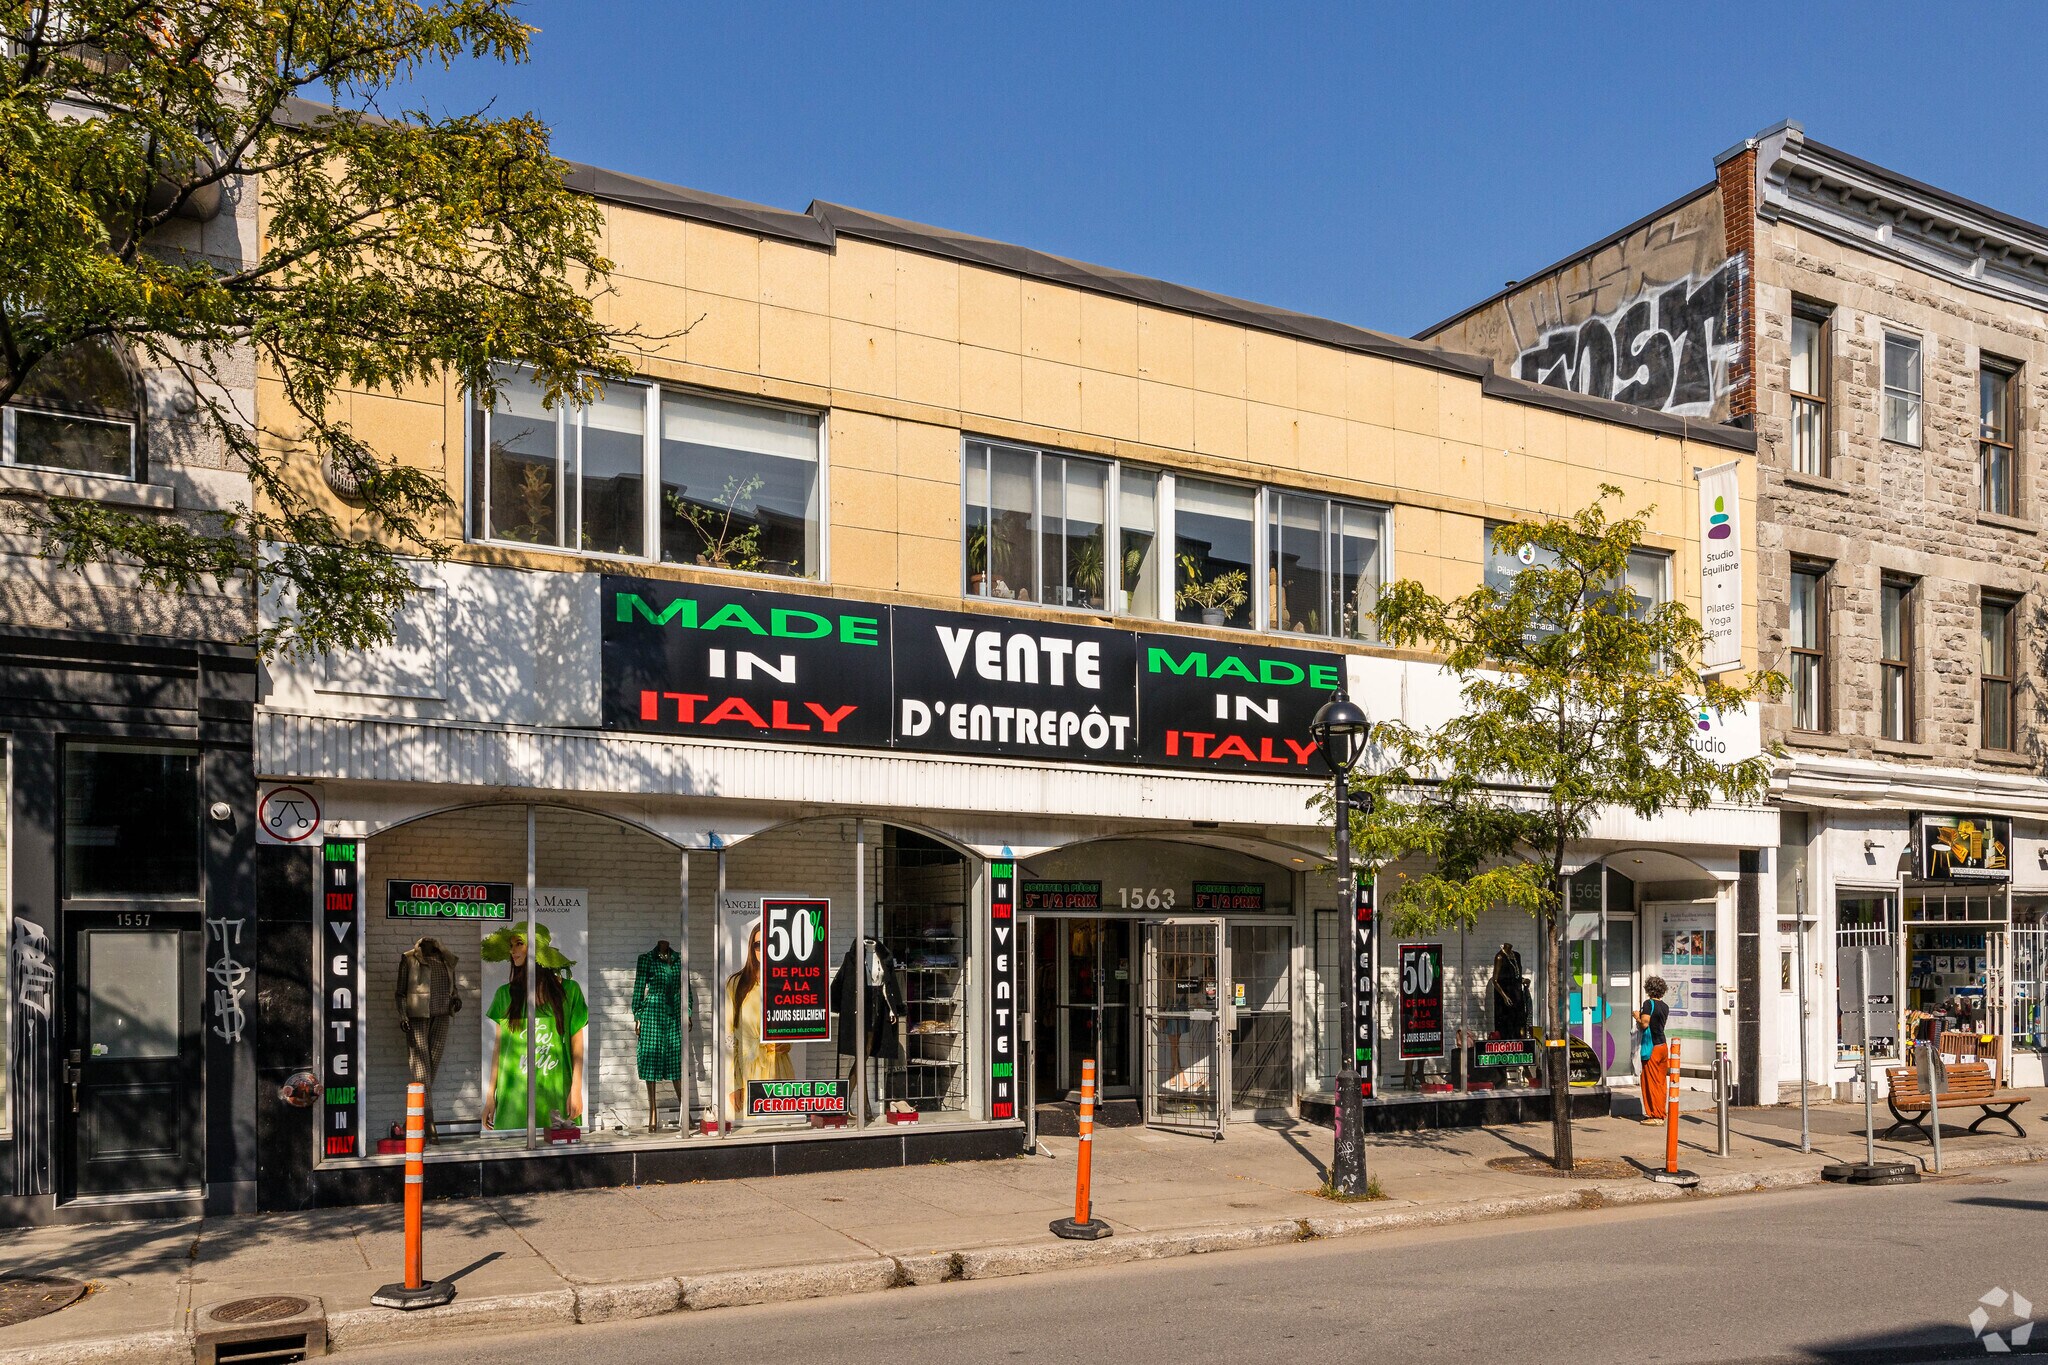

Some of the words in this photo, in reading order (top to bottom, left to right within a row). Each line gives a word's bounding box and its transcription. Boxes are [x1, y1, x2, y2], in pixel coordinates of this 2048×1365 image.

[1706, 550, 1734, 562] Studio
[1702, 562, 1739, 577] Équilibre
[1706, 603, 1735, 614] Pilates
[616, 592, 878, 646] MADE
[1709, 616, 1732, 627] Yoga
[1709, 628, 1732, 638] Barre
[935, 625, 1101, 690] VENTE
[709, 648, 796, 684] IN
[1147, 647, 1340, 690] MADE
[640, 690, 858, 733] ITALY
[1215, 694, 1280, 724] IN
[902, 698, 1130, 751] D'ENTREPÔT
[1165, 730, 1323, 765] ITALY
[1689, 736, 1726, 754] tudio
[326, 844, 355, 862] MADE
[335, 868, 346, 886] IN
[992, 863, 1012, 878] MADE
[411, 883, 487, 900] MAGASIN
[998, 883, 1006, 899] IN
[1024, 883, 1062, 892] ACHETER
[1062, 883, 1069, 893] 2
[1070, 882, 1099, 893] PIÈCES
[327, 893, 353, 911] ITALY
[544, 896, 581, 907] MARA
[724, 898, 760, 909] ANGEL
[1043, 893, 1063, 909] 1/2
[1065, 893, 1098, 908] PRIX
[1118, 888, 1175, 910] 1563
[1232, 895, 1261, 908] PRIX
[395, 900, 506, 918] TEMPORAIRE
[993, 903, 1011, 918] ITALY
[117, 914, 150, 926] 1557
[767, 908, 825, 962] 50%
[772, 967, 788, 977] DE
[791, 966, 820, 977] PLUS
[1403, 951, 1440, 995] 50%
[782, 979, 791, 991] À
[794, 981, 810, 991] LA
[995, 927, 1010, 1053] VENTE
[1358, 928, 1370, 1040] VENTE
[330, 921, 352, 1075] VENTE
[774, 993, 818, 1005] CAISSE
[1406, 999, 1416, 1008] DE
[1418, 998, 1437, 1007] PLUS
[767, 1009, 771, 1022] 3
[771, 1009, 791, 1022] JOURS
[792, 1008, 826, 1021] SEULEMENT
[1420, 1010, 1431, 1018] LA
[1407, 1020, 1436, 1029] CAISSE
[1485, 1042, 1523, 1053] MAGASIN
[1571, 1050, 1590, 1059] Faraj
[1478, 1053, 1533, 1065] TEMPORAIRE
[993, 1063, 1013, 1077] MADE
[326, 1086, 356, 1104] MADE
[762, 1082, 811, 1098] VENTE
[815, 1082, 837, 1096] DE
[999, 1082, 1007, 1097] IN
[753, 1097, 844, 1112] FERMETURE
[993, 1102, 1013, 1118] ITALY
[335, 1111, 347, 1129] IN
[327, 1136, 355, 1154] ITALY
